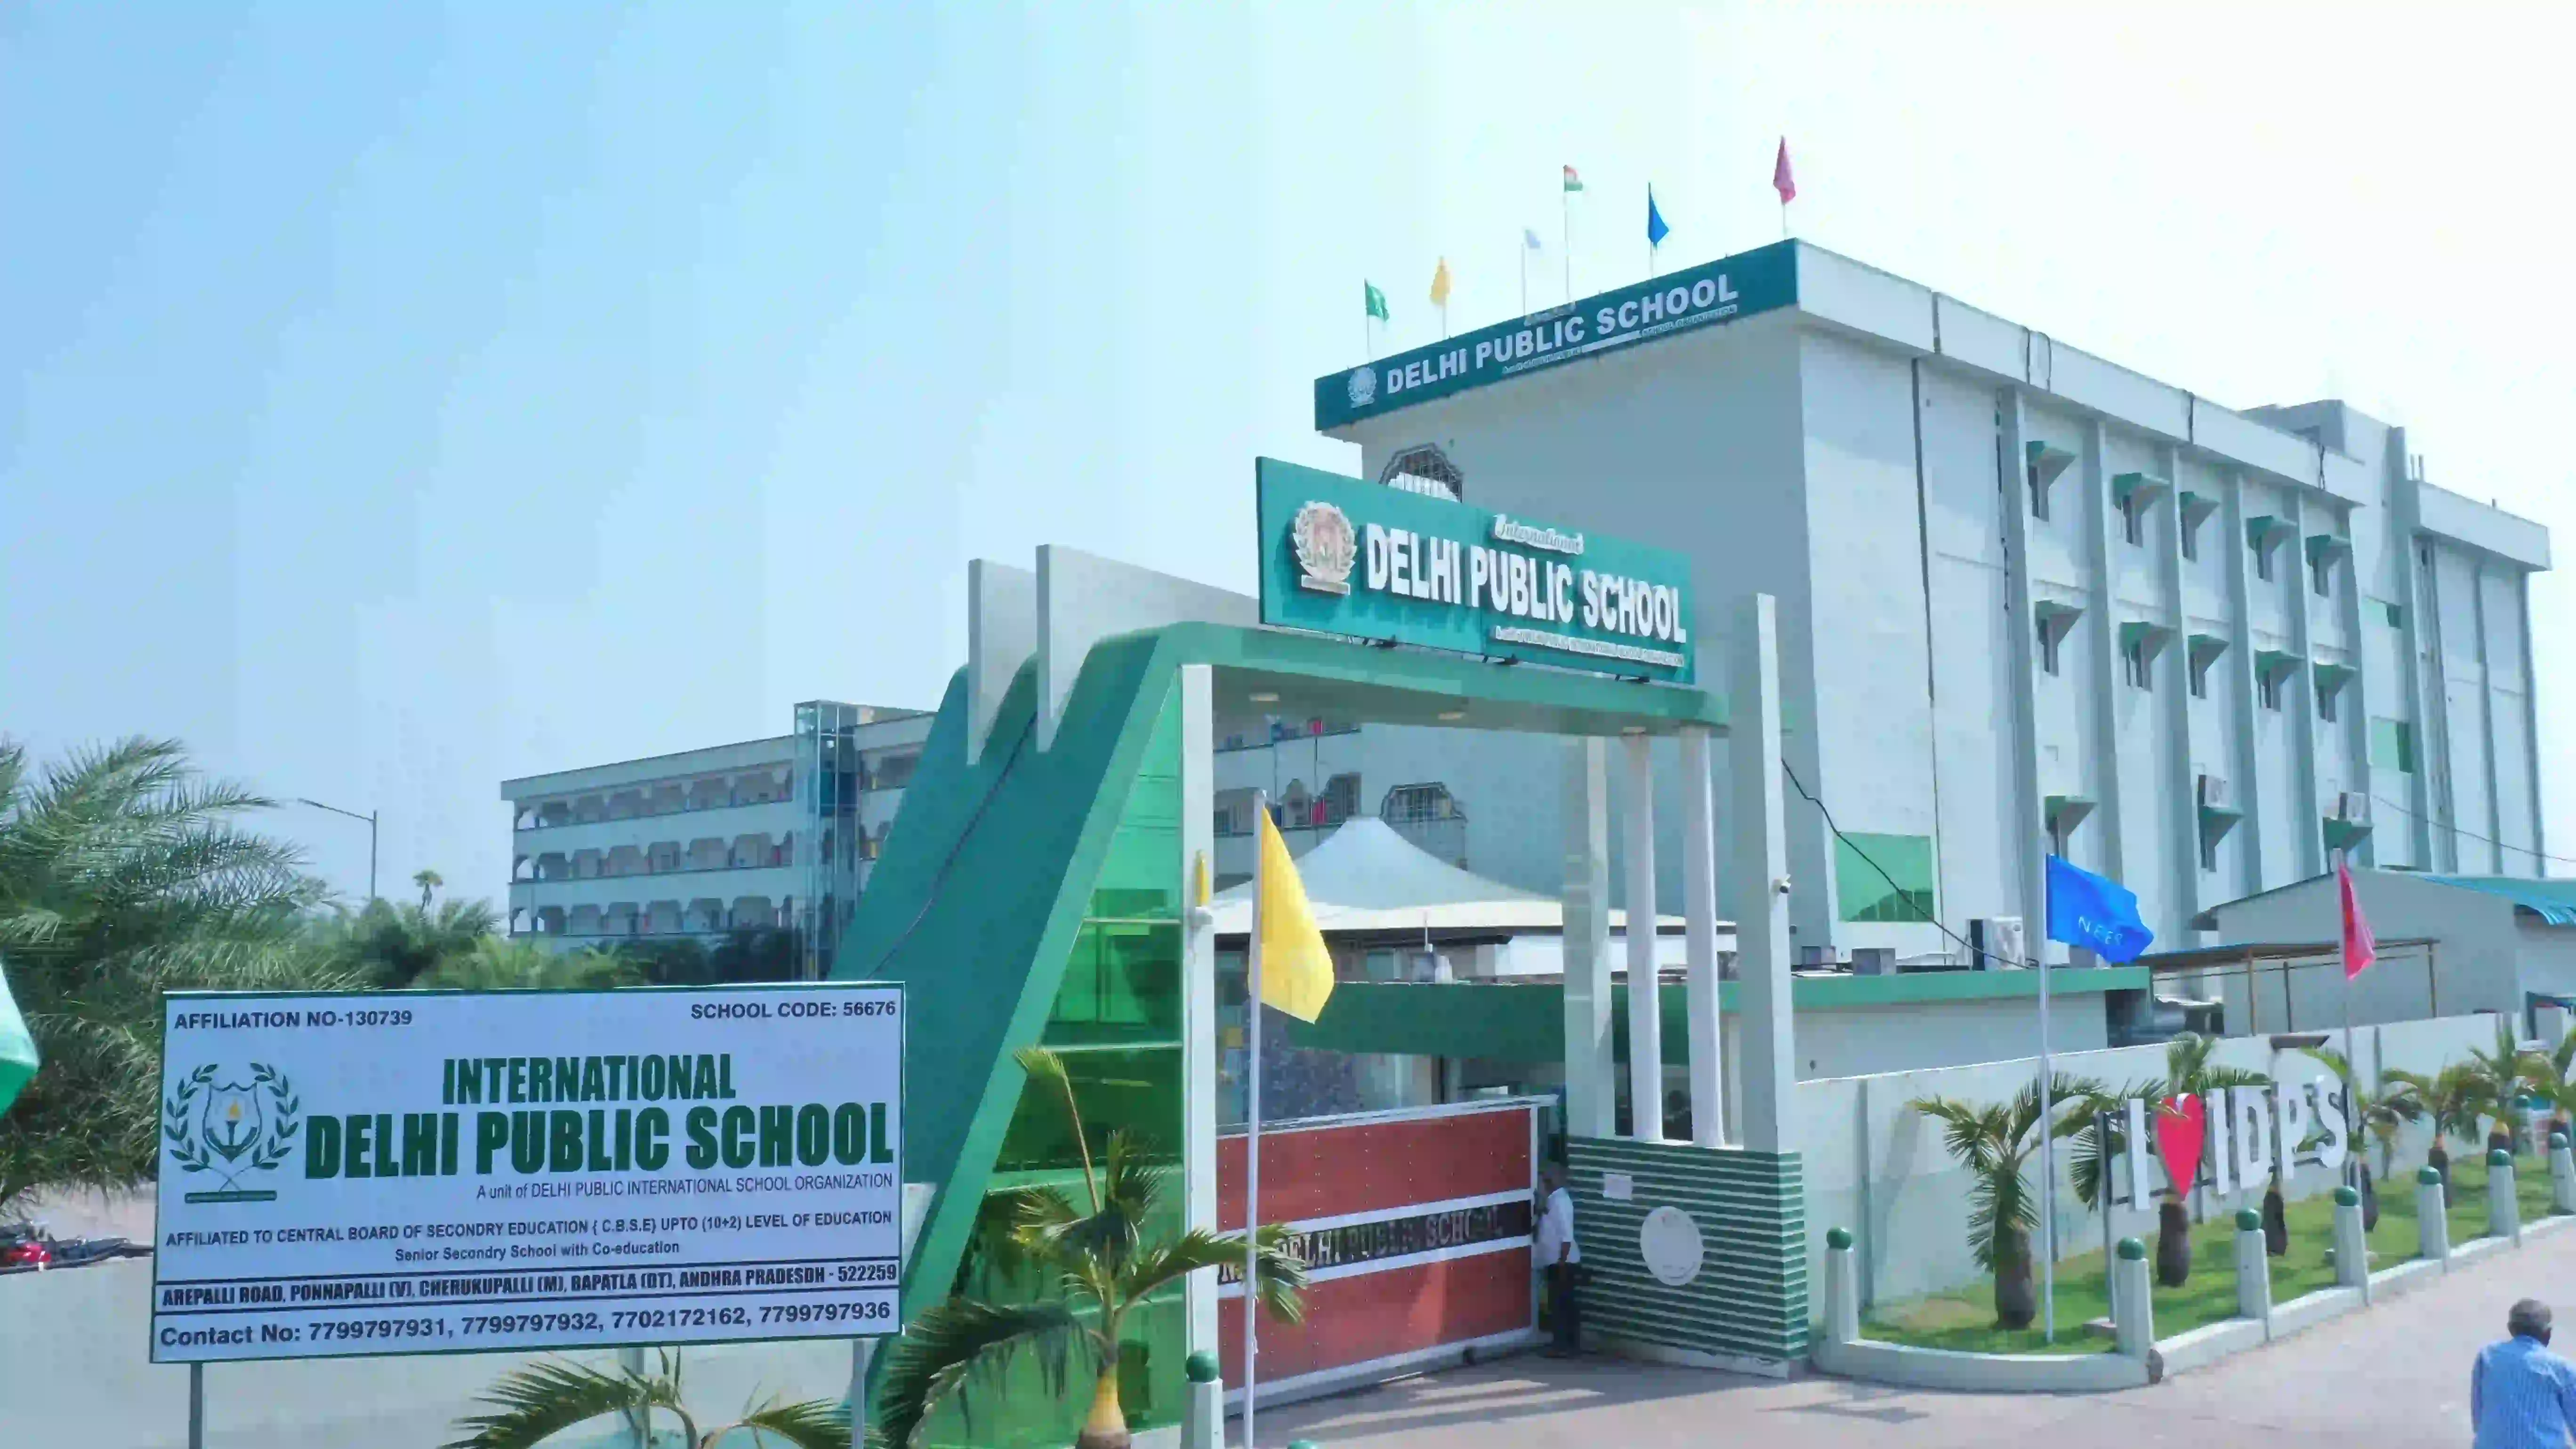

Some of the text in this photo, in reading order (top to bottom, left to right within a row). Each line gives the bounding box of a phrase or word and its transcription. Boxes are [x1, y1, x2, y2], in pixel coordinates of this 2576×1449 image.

[1387, 348, 1467, 394] DELHI
[1476, 316, 1585, 369] PUBLIC
[1596, 274, 1739, 335] SCHOOL
[1367, 523, 1687, 643] DELHI PUBLIC SCHOOL
[174, 1011, 412, 1029] AFFILIATION NO-130739
[691, 1001, 895, 1019] SCHOOL CODE: 56676
[443, 1054, 737, 1104] INTERNATIONAL
[305, 1102, 894, 1179] DELHI PUBLIC SCHOOL
[2126, 1074, 2347, 1211] I IDPS
[476, 1173, 892, 1199] A unit of DELHI PUBLIC INTERNATIONAL SCHOOL ORGANIZATION
[166, 1230, 248, 1246] AFFILIATED
[254, 1229, 272, 1243] TO
[278, 1227, 344, 1242] CENTRAL
[348, 1226, 399, 1240] BOARD
[403, 1225, 421, 1239] OF
[427, 1223, 503, 1238] SECONDRY
[508, 1220, 588, 1236] EDUCATION
[661, 1217, 698, 1231] UPTO
[746, 1214, 788, 1229] LEVEL
[792, 1213, 810, 1227] OF
[815, 1210, 891, 1226] EDUCATION
[1426, 1205, 1503, 1248] SCHOL
[395, 1241, 679, 1262] Senior Secondry School with Co-education
[163, 1287, 234, 1306] AREPALLI
[240, 1285, 285, 1303] ROAD,
[291, 1282, 385, 1302] PONNAPALLI
[420, 1276, 533, 1297] CHERUKUPALLI
[572, 1273, 636, 1290] BAPATLA
[679, 1270, 741, 1288] ANDHRA
[838, 1264, 896, 1282] 522259
[161, 1302, 890, 1346] Contact No: 7799797931, 7799797932, 7702172162, 7799797936
